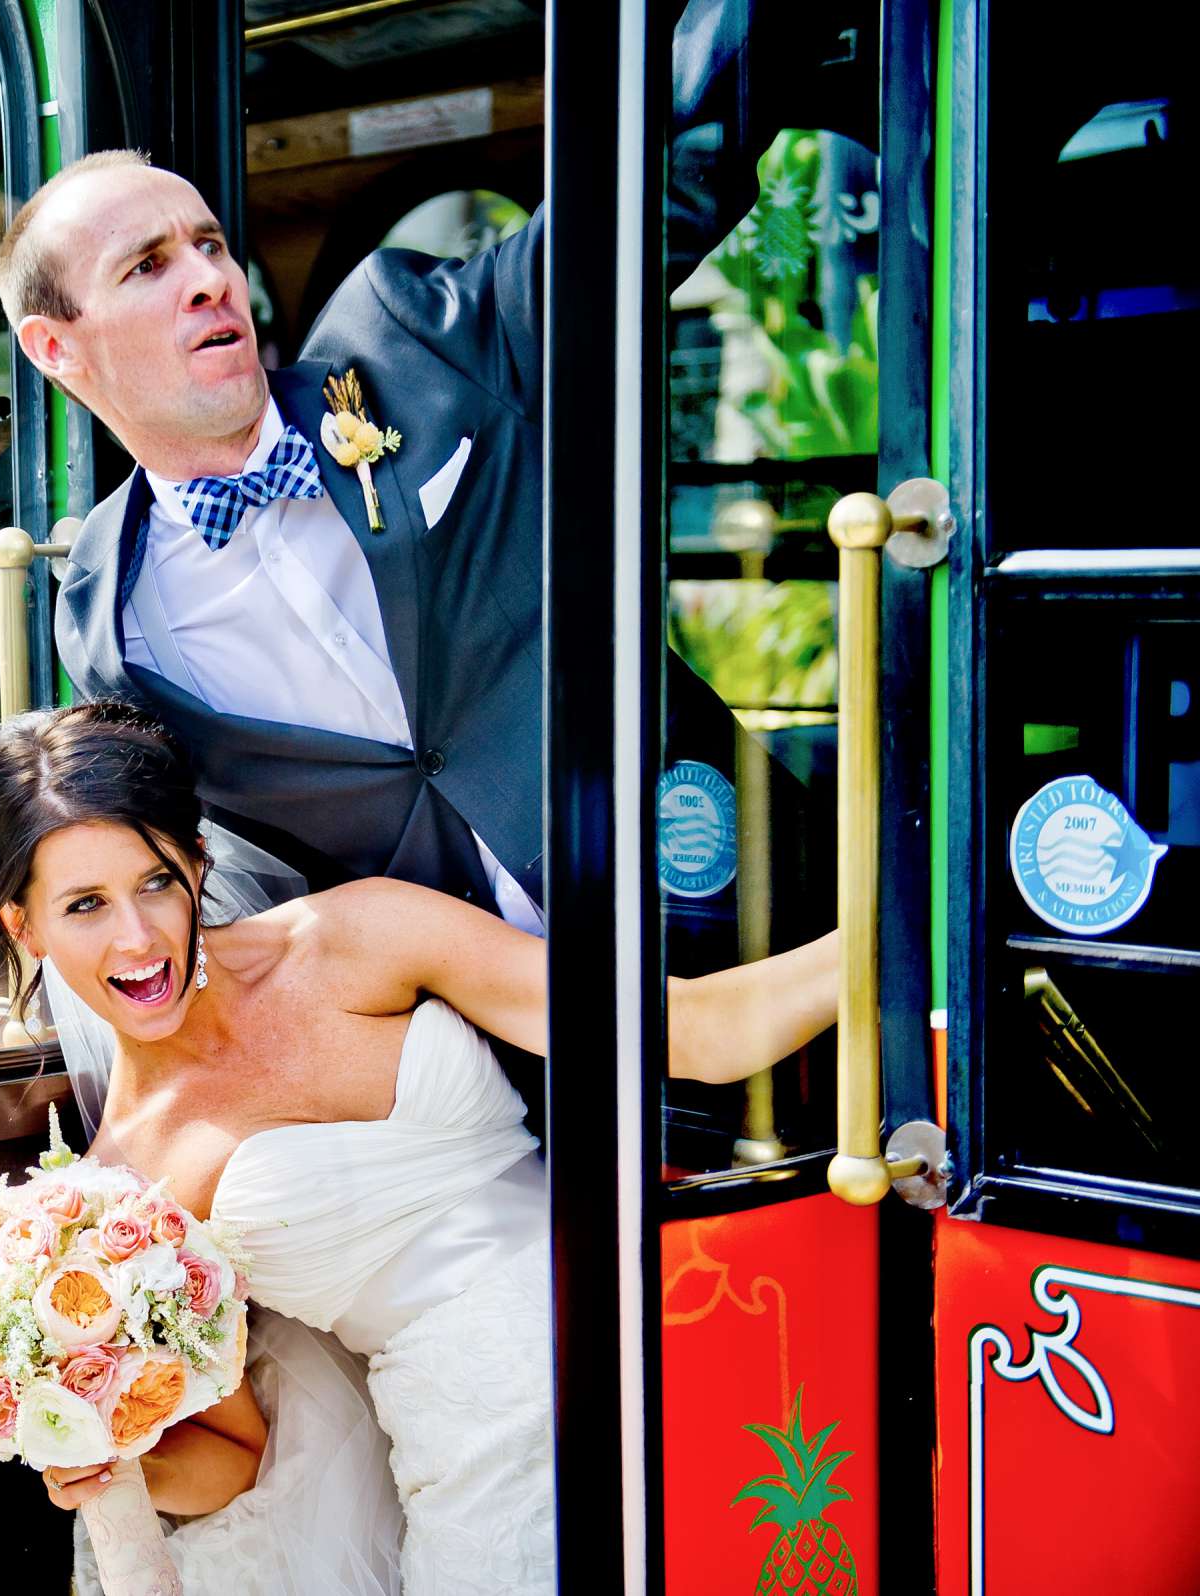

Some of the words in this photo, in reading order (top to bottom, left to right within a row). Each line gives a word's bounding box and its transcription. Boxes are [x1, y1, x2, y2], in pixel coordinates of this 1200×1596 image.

[1018, 789, 1063, 877] TRUSTED
[1066, 783, 1129, 824] TOURS
[1063, 815, 1098, 831] 2007
[1055, 881, 1107, 896] MEMBER
[1051, 884, 1138, 922] ATTRACTIONS
